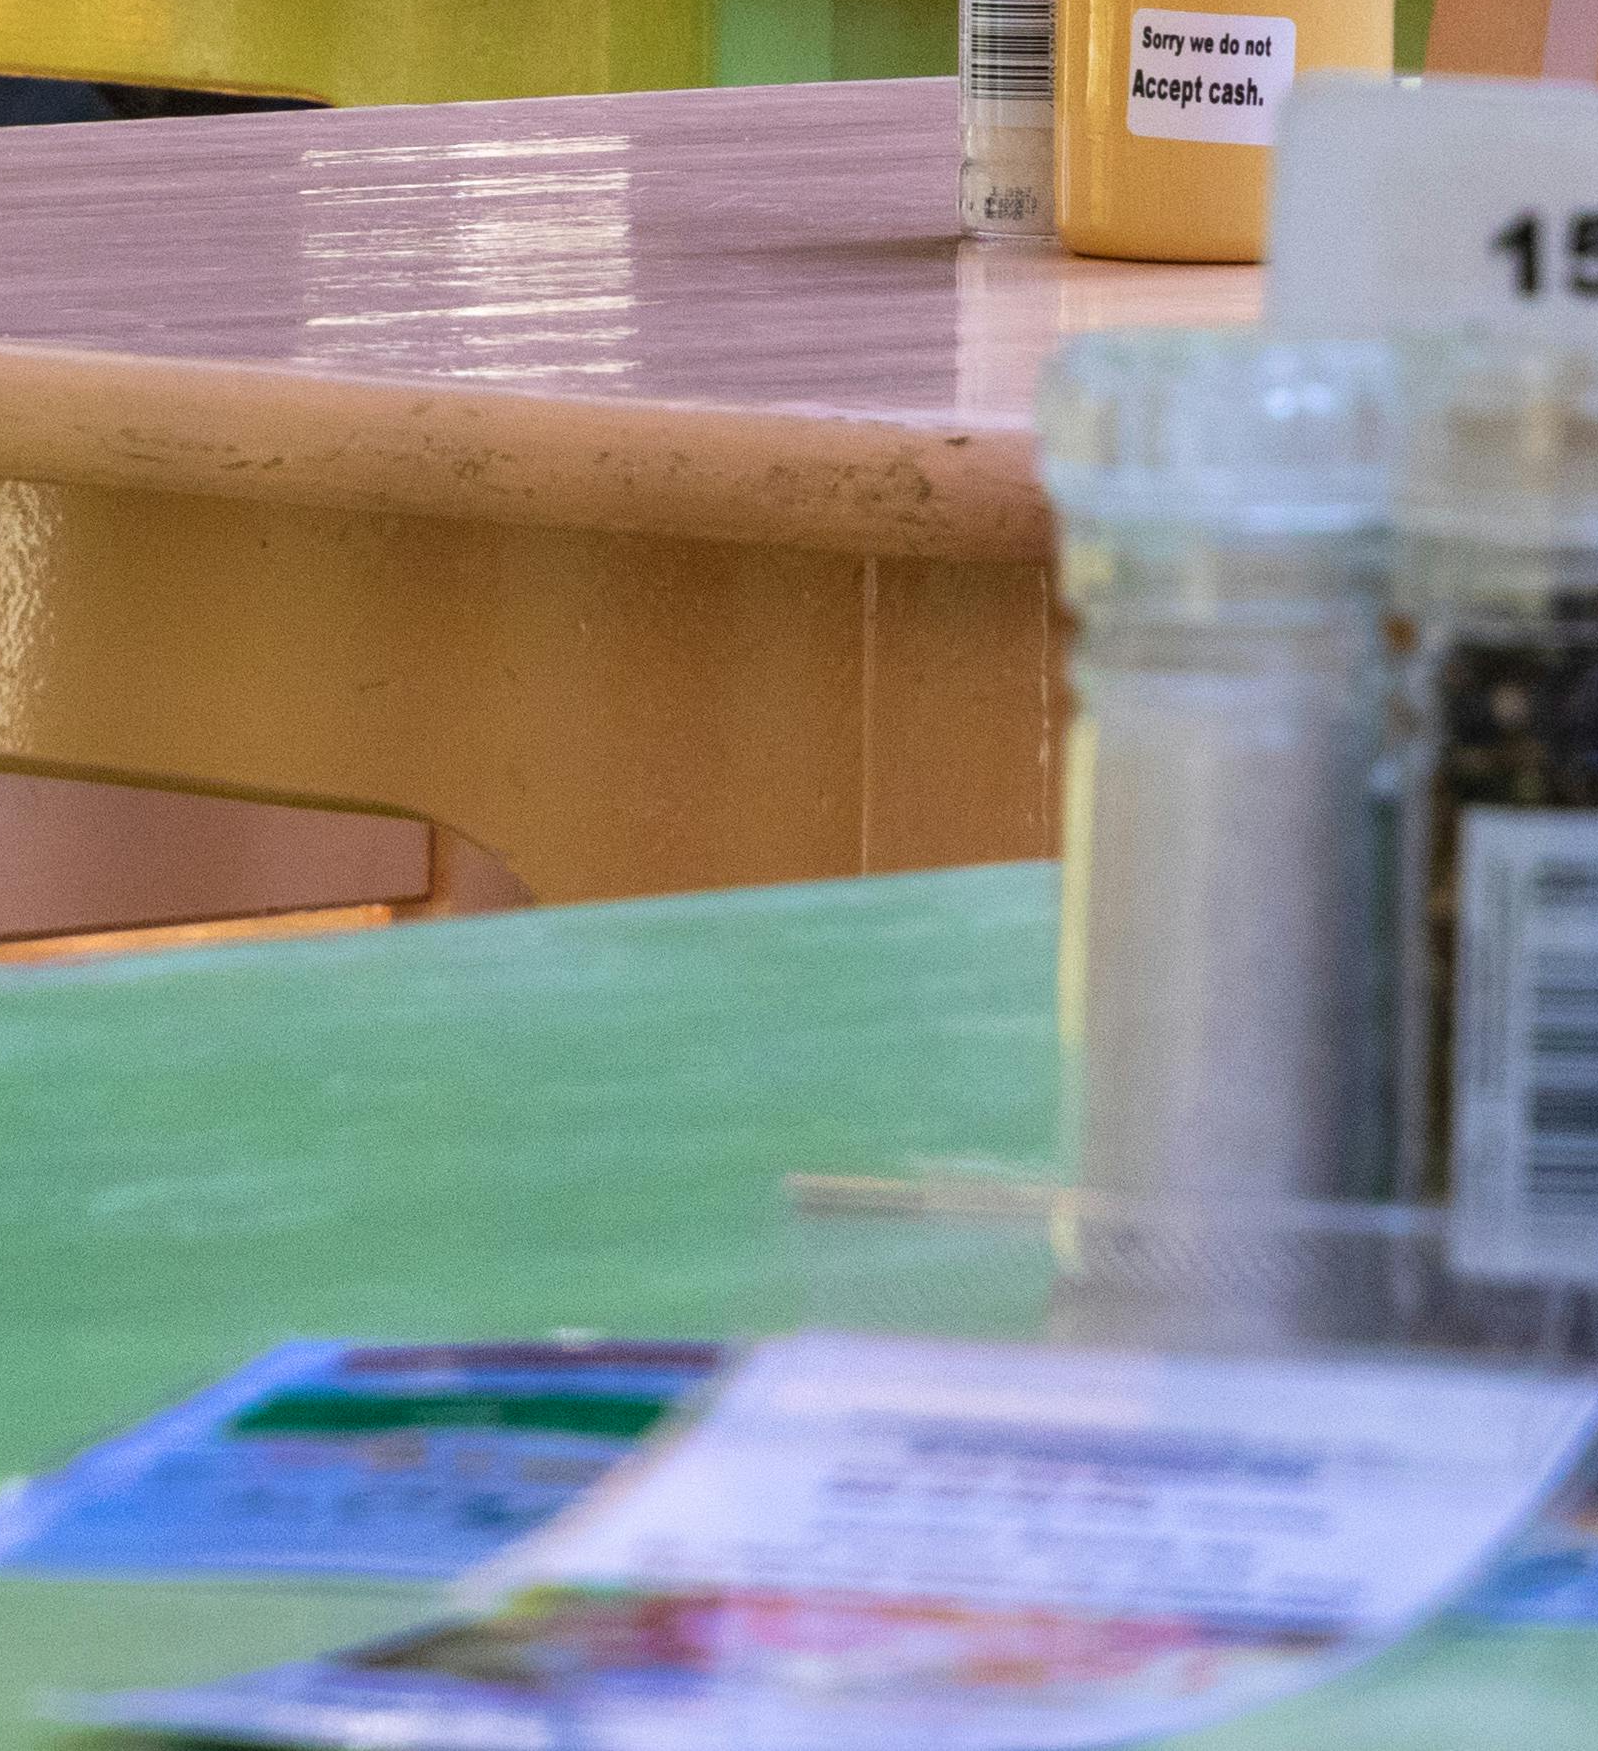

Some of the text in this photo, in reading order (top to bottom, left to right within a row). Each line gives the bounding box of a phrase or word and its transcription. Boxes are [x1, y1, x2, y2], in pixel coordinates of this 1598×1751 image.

[1142, 26, 1272, 57] Sorry we do not
[1132, 68, 1264, 109] Accept cash.
